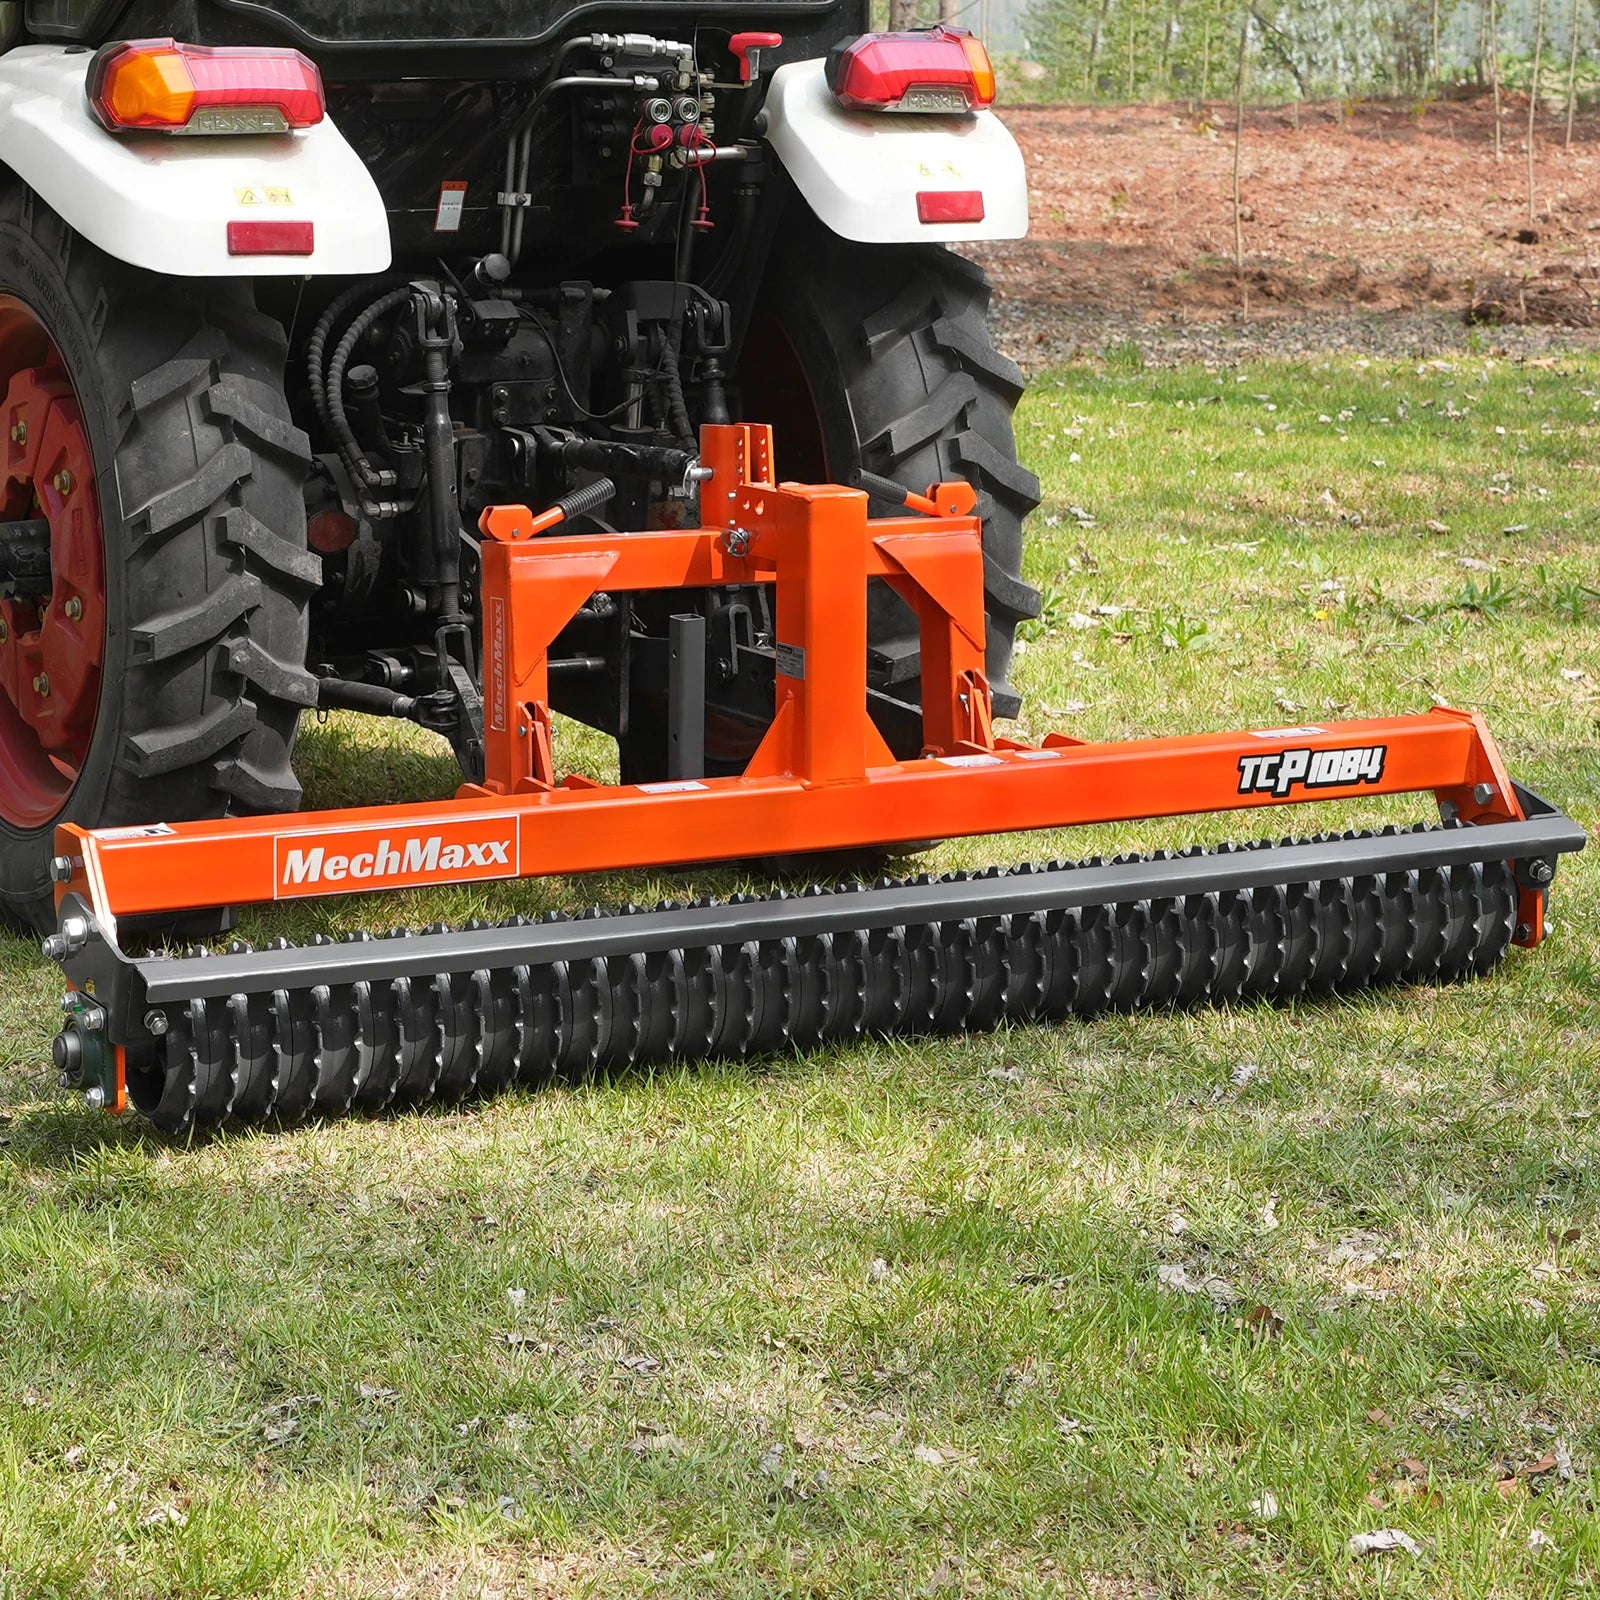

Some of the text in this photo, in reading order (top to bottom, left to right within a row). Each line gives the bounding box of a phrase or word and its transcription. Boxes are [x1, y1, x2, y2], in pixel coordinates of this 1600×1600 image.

[494, 601, 504, 727] MechMaxx
[1238, 746, 1386, 797] TCP1084
[282, 836, 511, 885] MechMaxx
